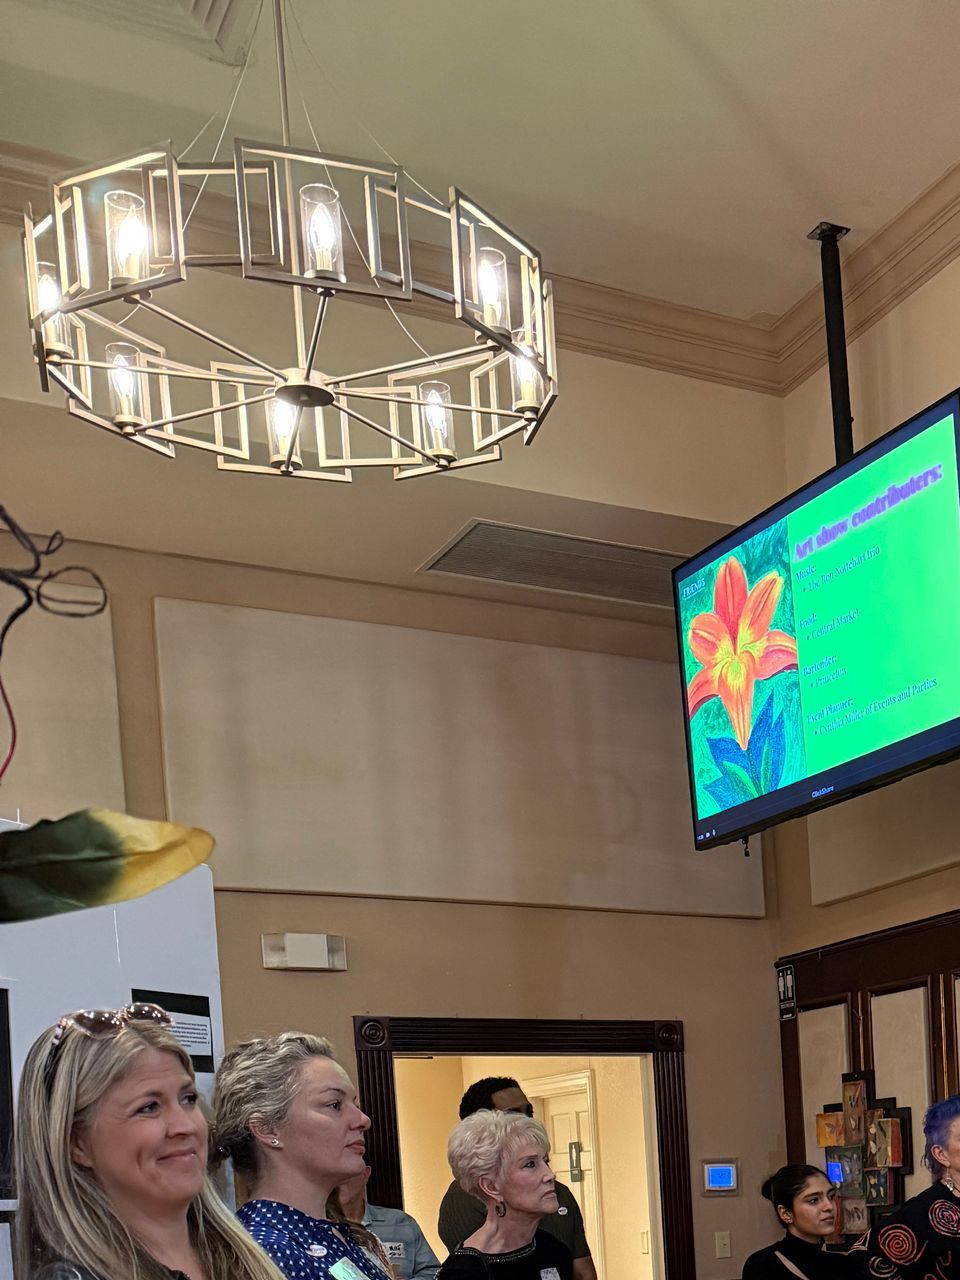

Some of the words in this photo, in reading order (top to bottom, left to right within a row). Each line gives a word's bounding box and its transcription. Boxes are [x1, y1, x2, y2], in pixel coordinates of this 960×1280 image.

[795, 537, 814, 560] Art
[816, 519, 849, 548] show
[795, 565, 817, 581] Music:
[812, 619, 835, 640] Central
[836, 608, 860, 626] Market
[873, 695, 897, 713] Events
[897, 687, 911, 702] and
[912, 678, 937, 696] Parties
[807, 708, 826, 724] Event
